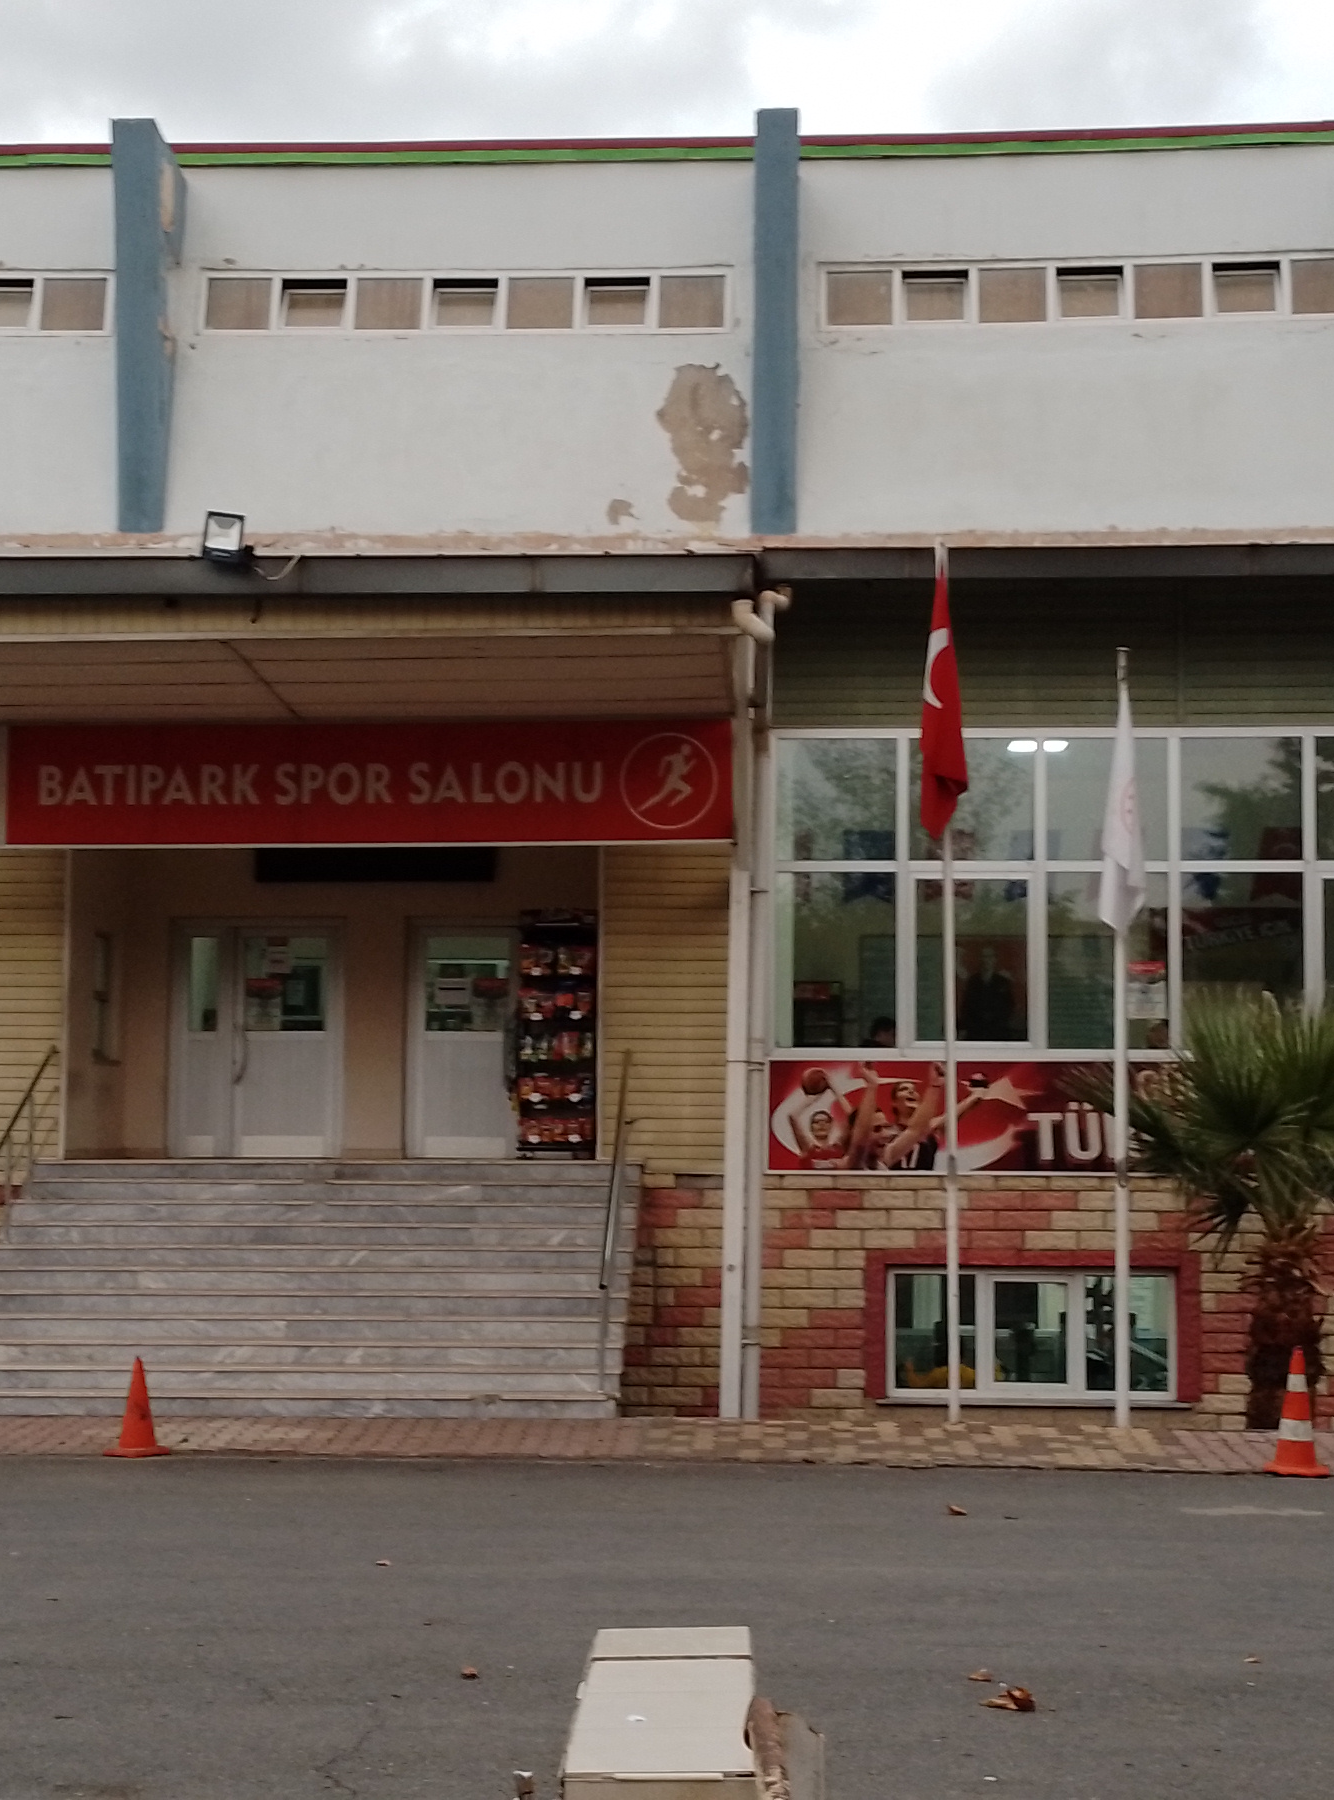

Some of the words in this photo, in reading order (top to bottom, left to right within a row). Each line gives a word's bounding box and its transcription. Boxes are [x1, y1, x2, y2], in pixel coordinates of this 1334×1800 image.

[38, 763, 261, 806] BATIPARK
[274, 762, 394, 805] SPOR
[407, 760, 603, 804] SALONU
